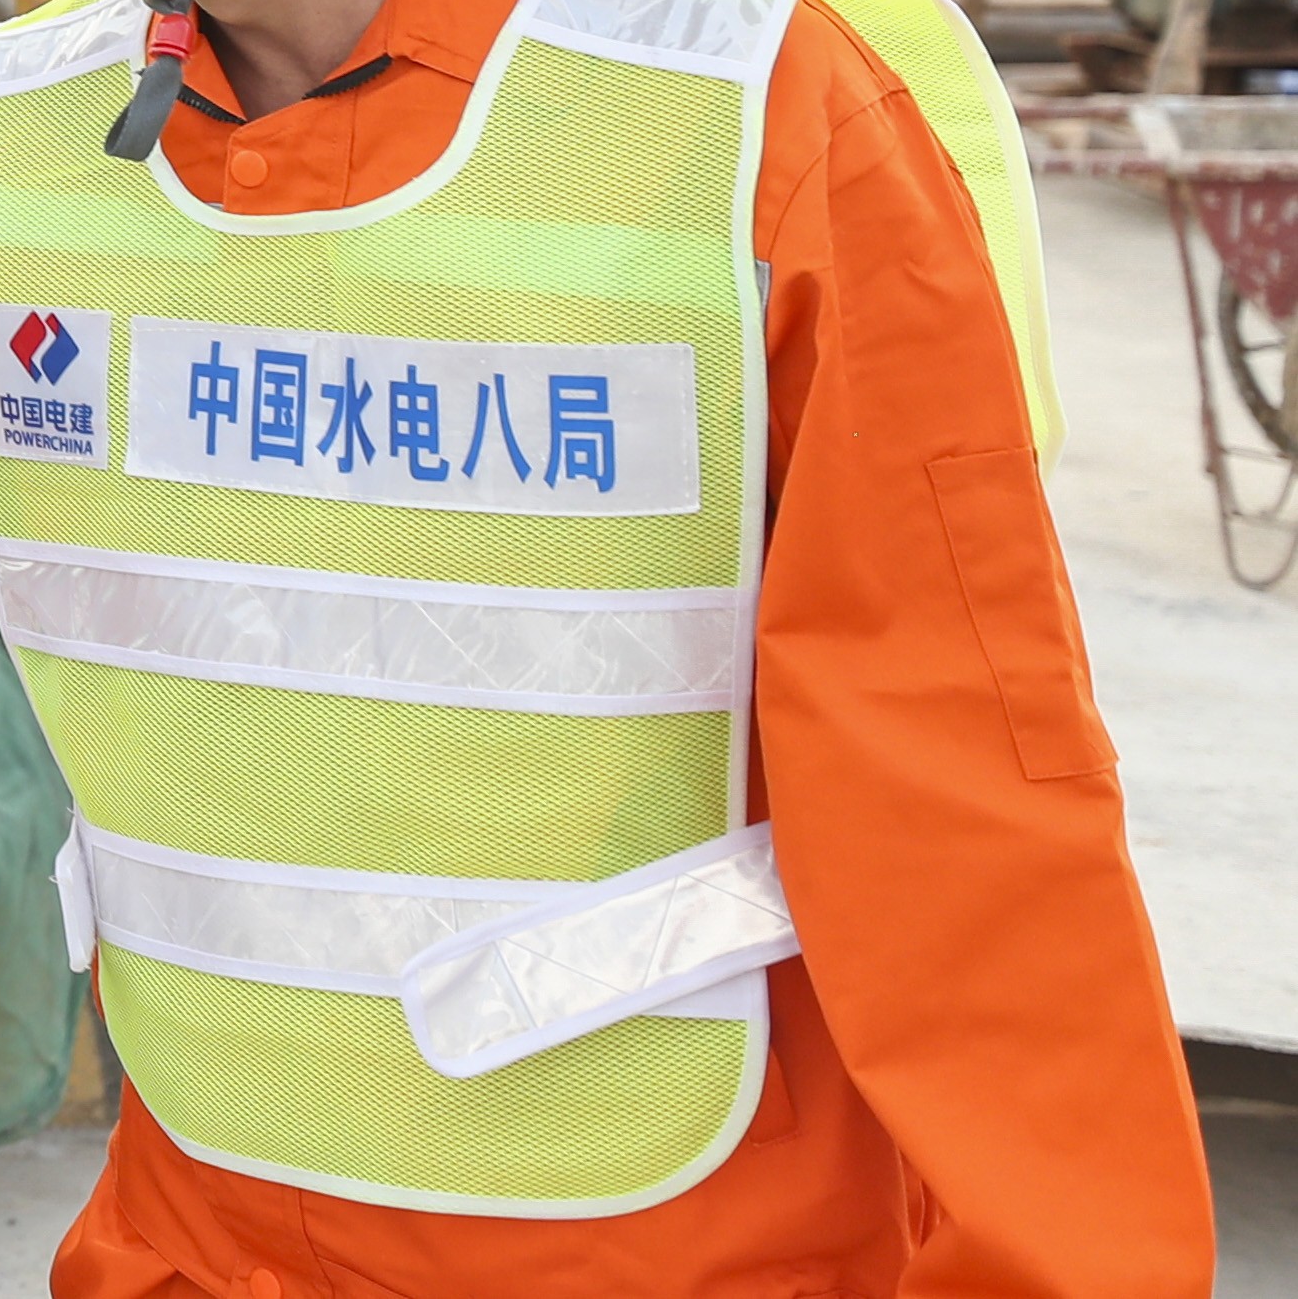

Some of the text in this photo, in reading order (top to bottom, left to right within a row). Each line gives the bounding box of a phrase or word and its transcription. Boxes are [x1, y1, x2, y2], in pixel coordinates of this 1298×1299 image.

[0, 392, 94, 435] 中国电建
[188, 339, 616, 493] 中国水电八局
[4, 428, 94, 455] POWERCHINA
